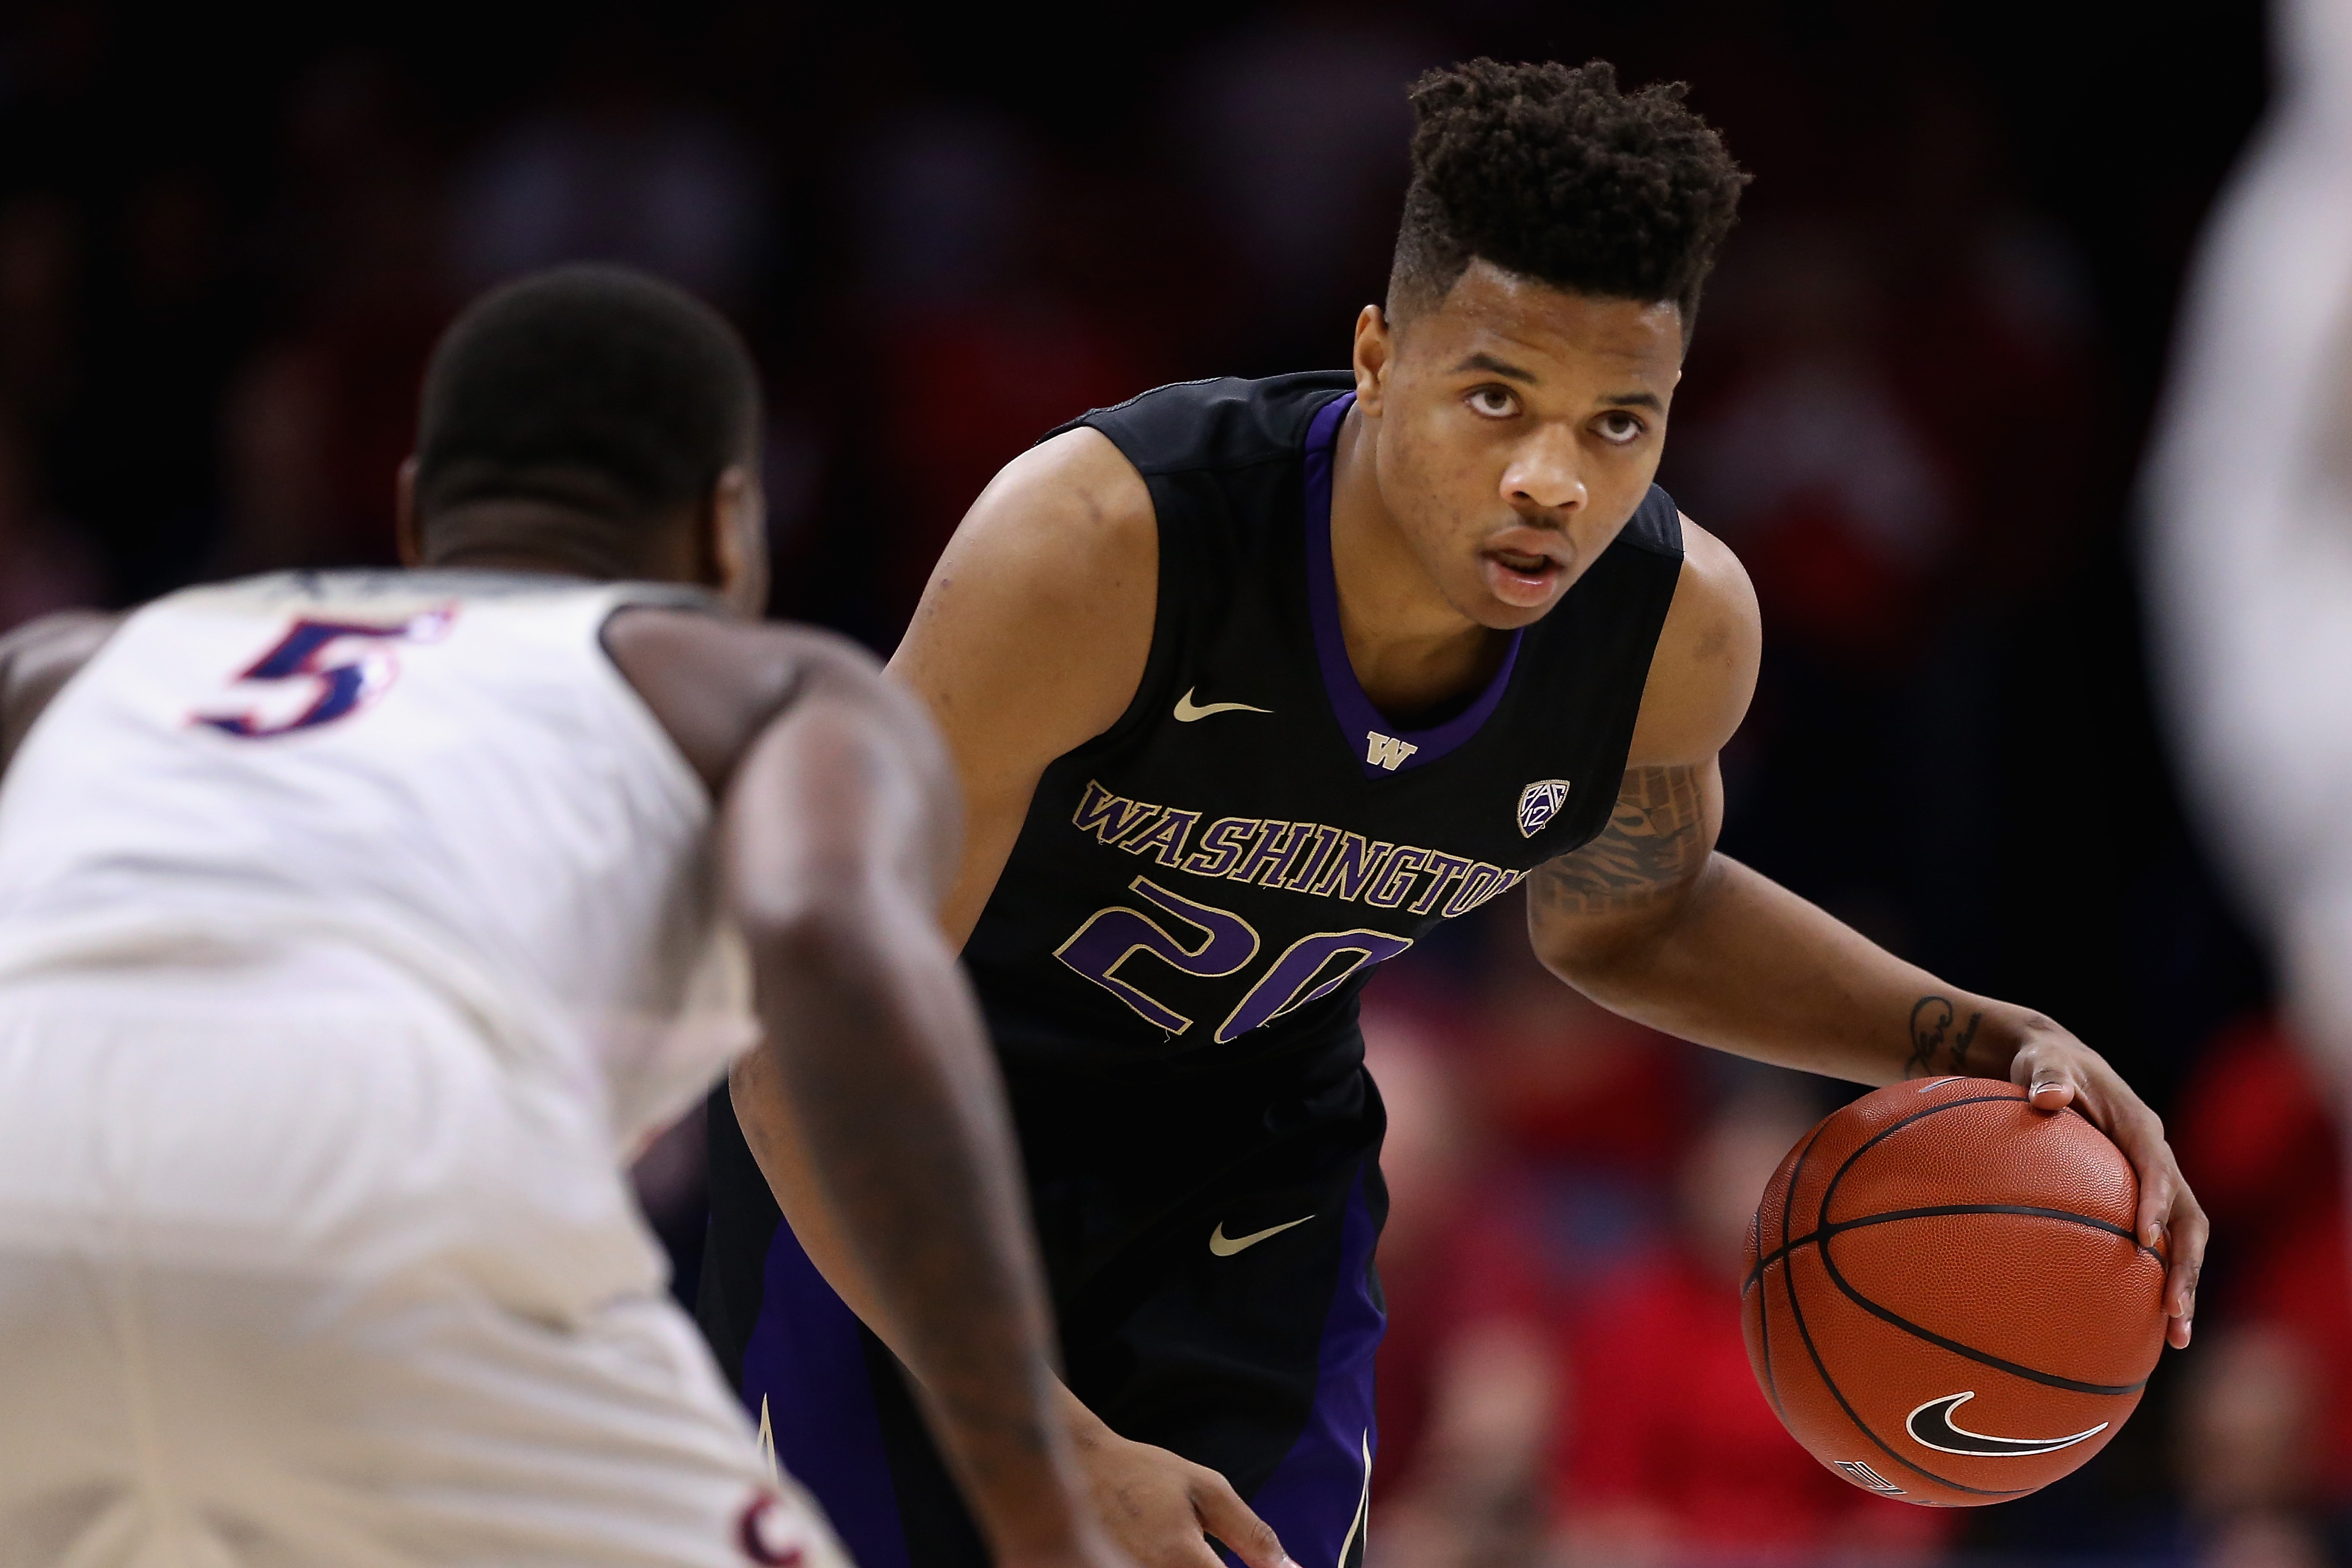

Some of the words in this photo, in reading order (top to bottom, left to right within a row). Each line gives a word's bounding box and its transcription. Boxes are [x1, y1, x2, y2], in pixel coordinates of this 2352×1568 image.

[185, 602, 457, 739] 5
[1366, 731, 1419, 771] W
[1520, 784, 1567, 817] PAC
[1523, 805, 1550, 827] 12
[1053, 875, 1414, 1044] 20
